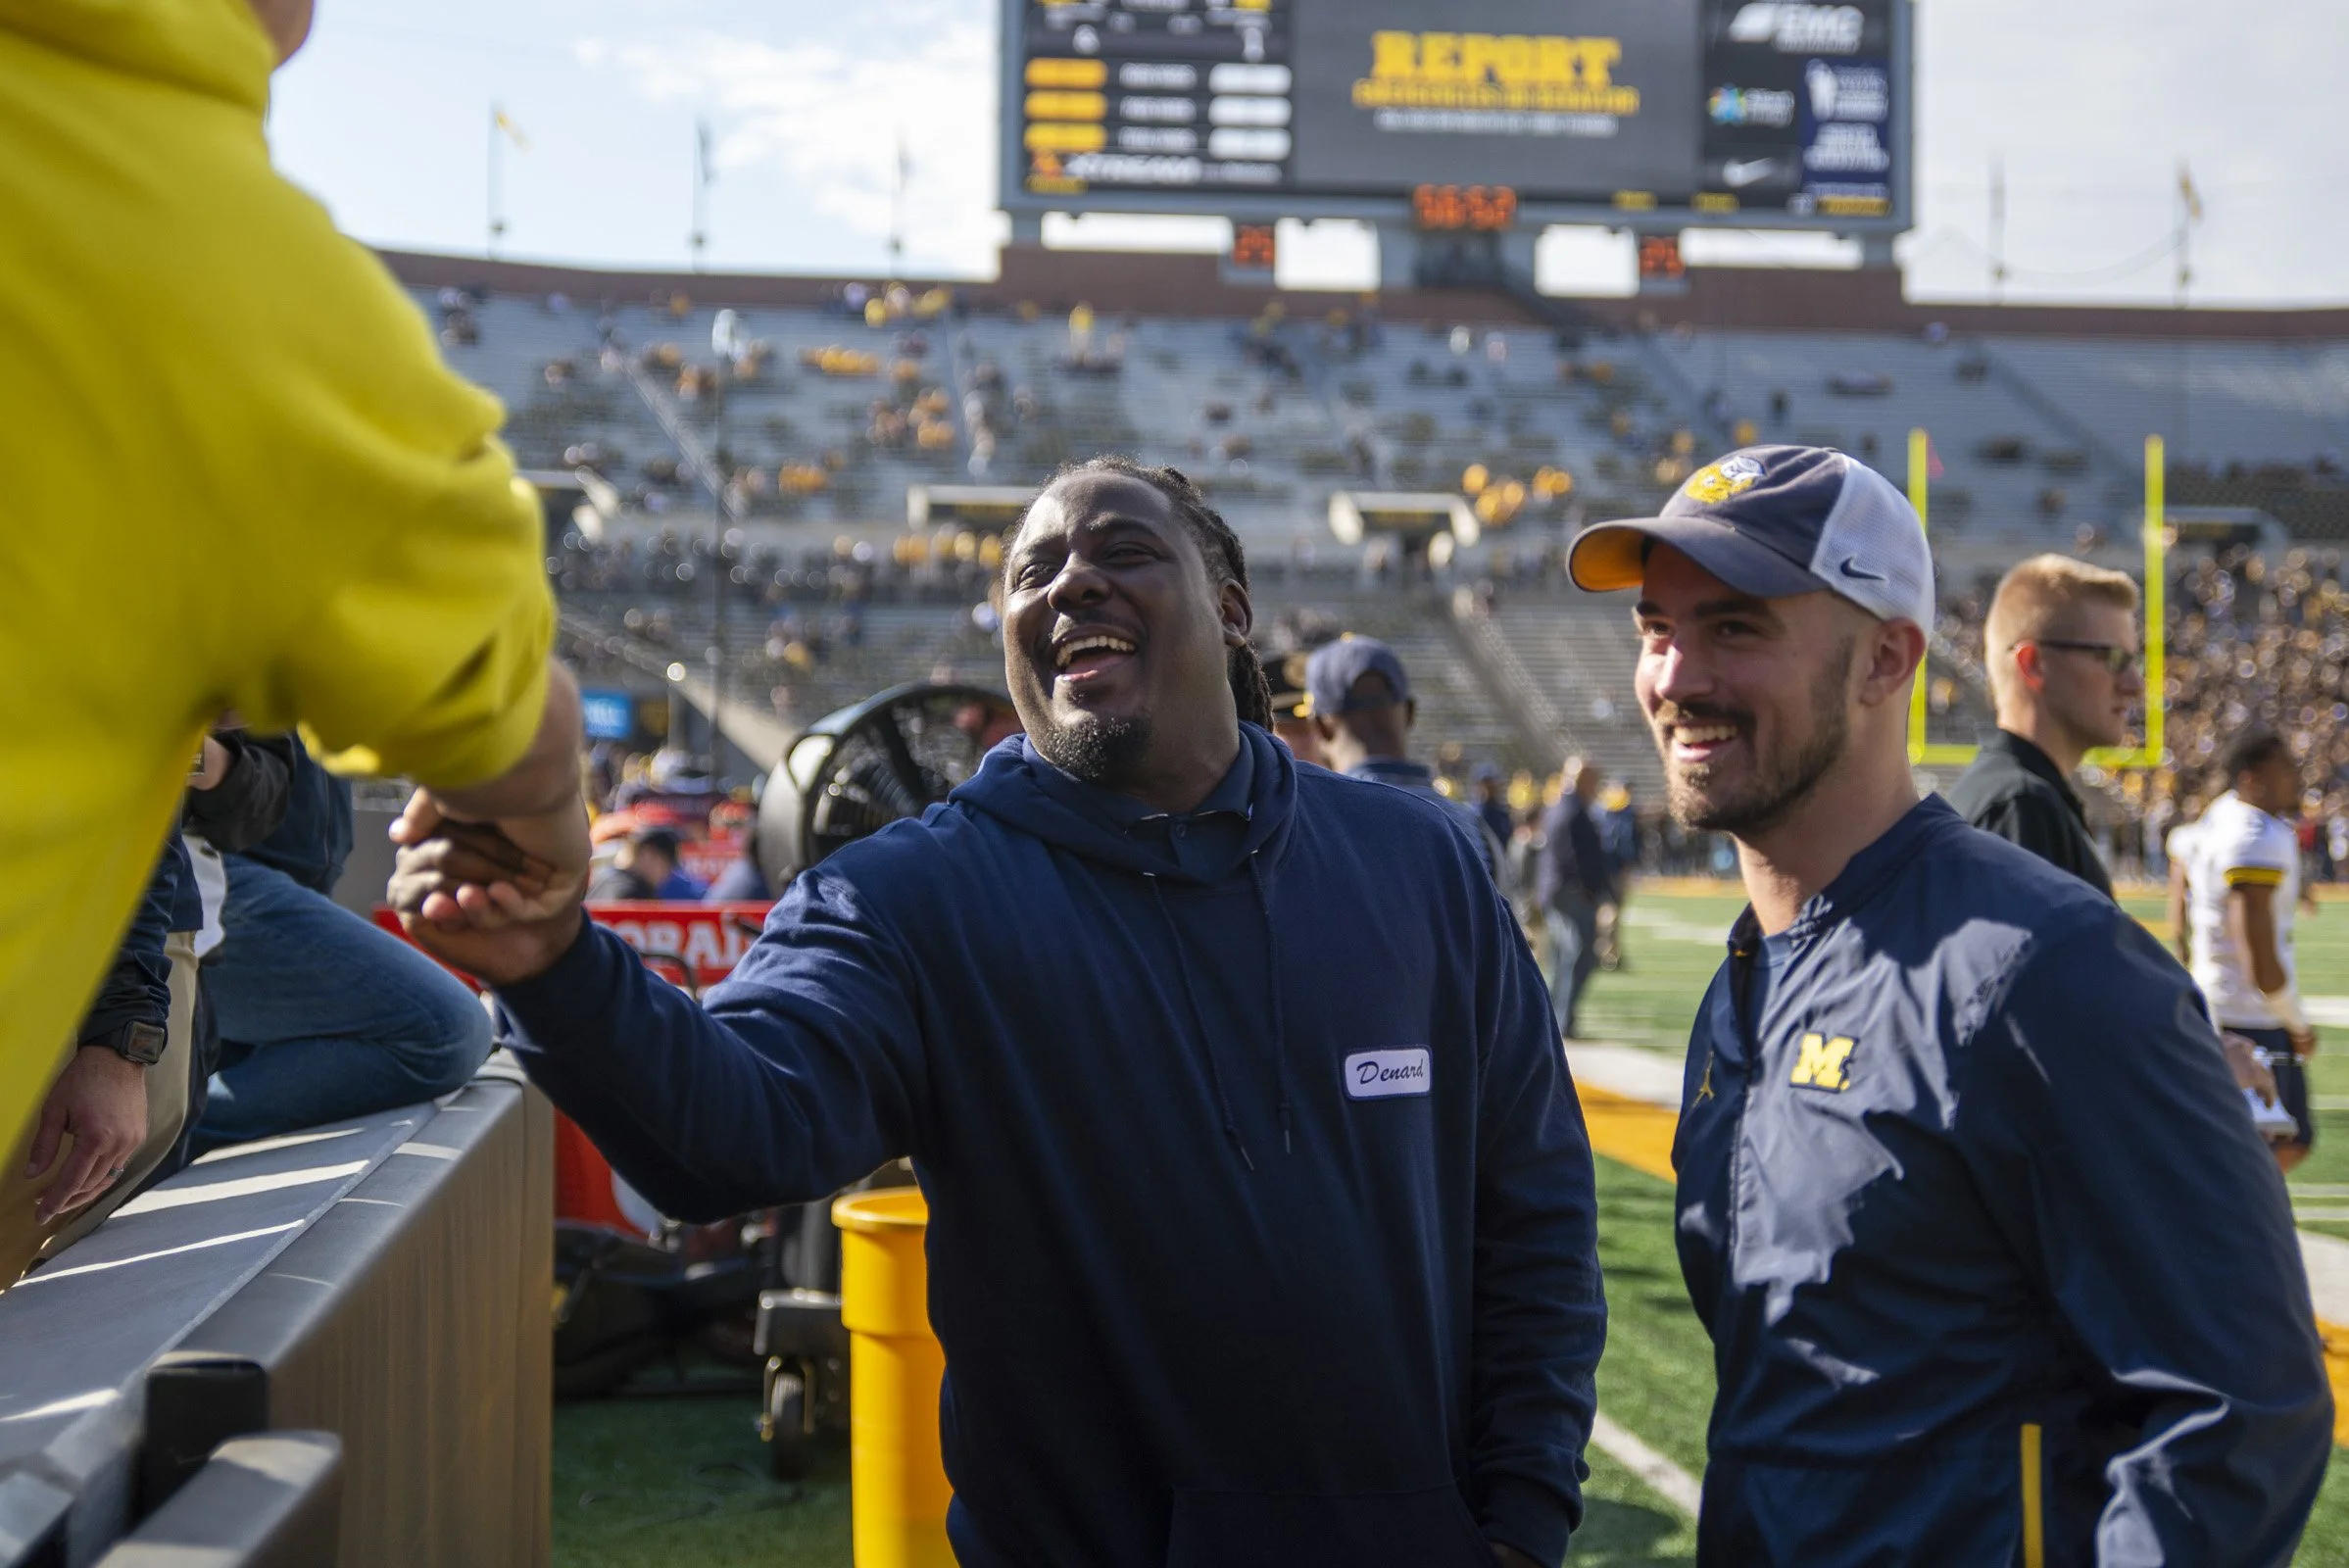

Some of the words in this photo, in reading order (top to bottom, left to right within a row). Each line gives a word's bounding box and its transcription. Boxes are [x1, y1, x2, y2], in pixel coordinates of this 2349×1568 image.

[1372, 30, 1622, 85] REPORT
[1356, 1058, 1424, 1085] Denard
[1789, 1033, 1858, 1093] M
